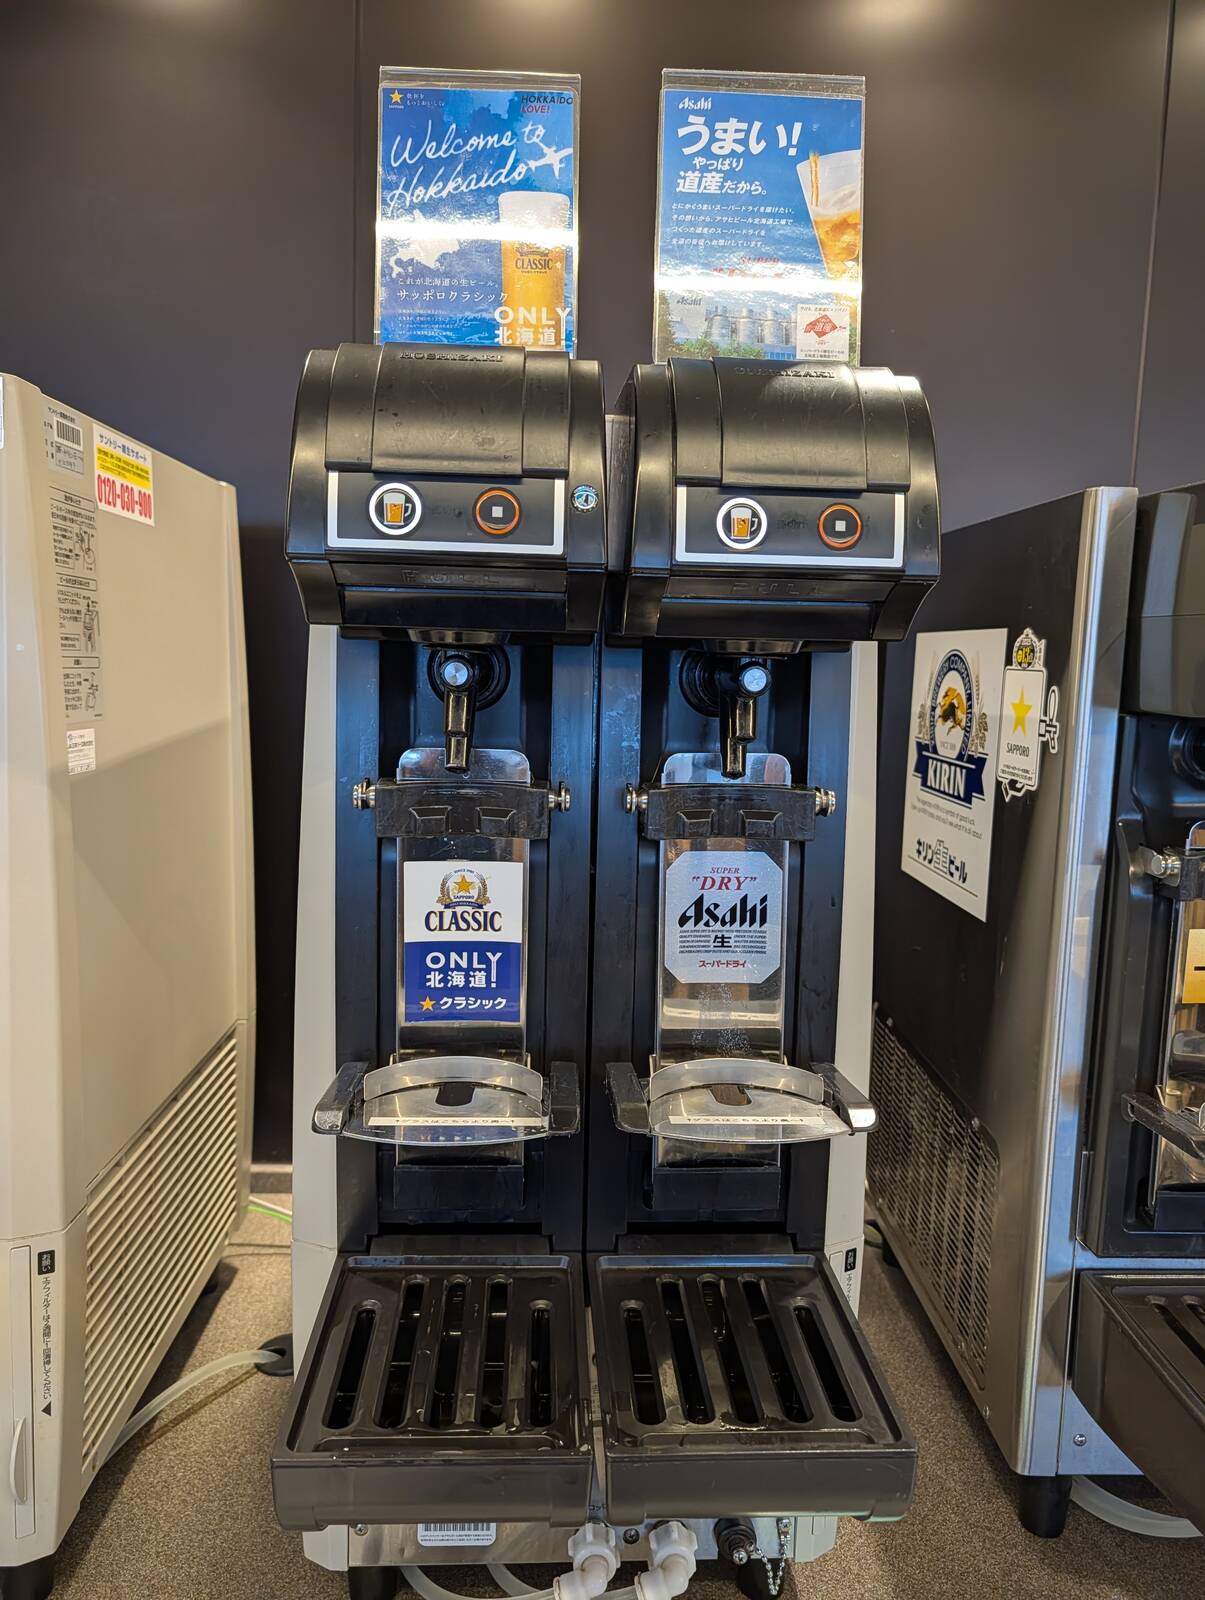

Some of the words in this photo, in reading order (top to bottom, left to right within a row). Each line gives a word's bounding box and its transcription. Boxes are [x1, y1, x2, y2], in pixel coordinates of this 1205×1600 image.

[521, 95, 573, 105] HOKKAIDO
[679, 97, 712, 111] Asahi
[521, 105, 550, 113] LOVE!
[390, 119, 518, 168] Welcome
[521, 120, 547, 144] to
[693, 156, 744, 171] やっぱり
[386, 149, 530, 217] Hokkaido
[676, 170, 767, 196] 道産だから。
[515, 257, 554, 271] CLASSIC
[396, 289, 510, 303] サッポロクラシック
[676, 296, 703, 307] Asahi
[494, 306, 572, 326] ONLY
[96, 474, 153, 520] 0120-030-900
[1006, 742, 1030, 759] SAPPORO
[926, 757, 966, 799] KIRIN
[916, 838, 968, 884] キリン生ビール
[710, 866, 740, 874] SUPER
[678, 893, 768, 928] Asahi
[424, 910, 502, 932] CLASSIC
[713, 934, 733, 949] 生
[425, 951, 503, 970] ONLY
[698, 960, 748, 969] スーパードライ
[440, 996, 507, 1010] クラシック
